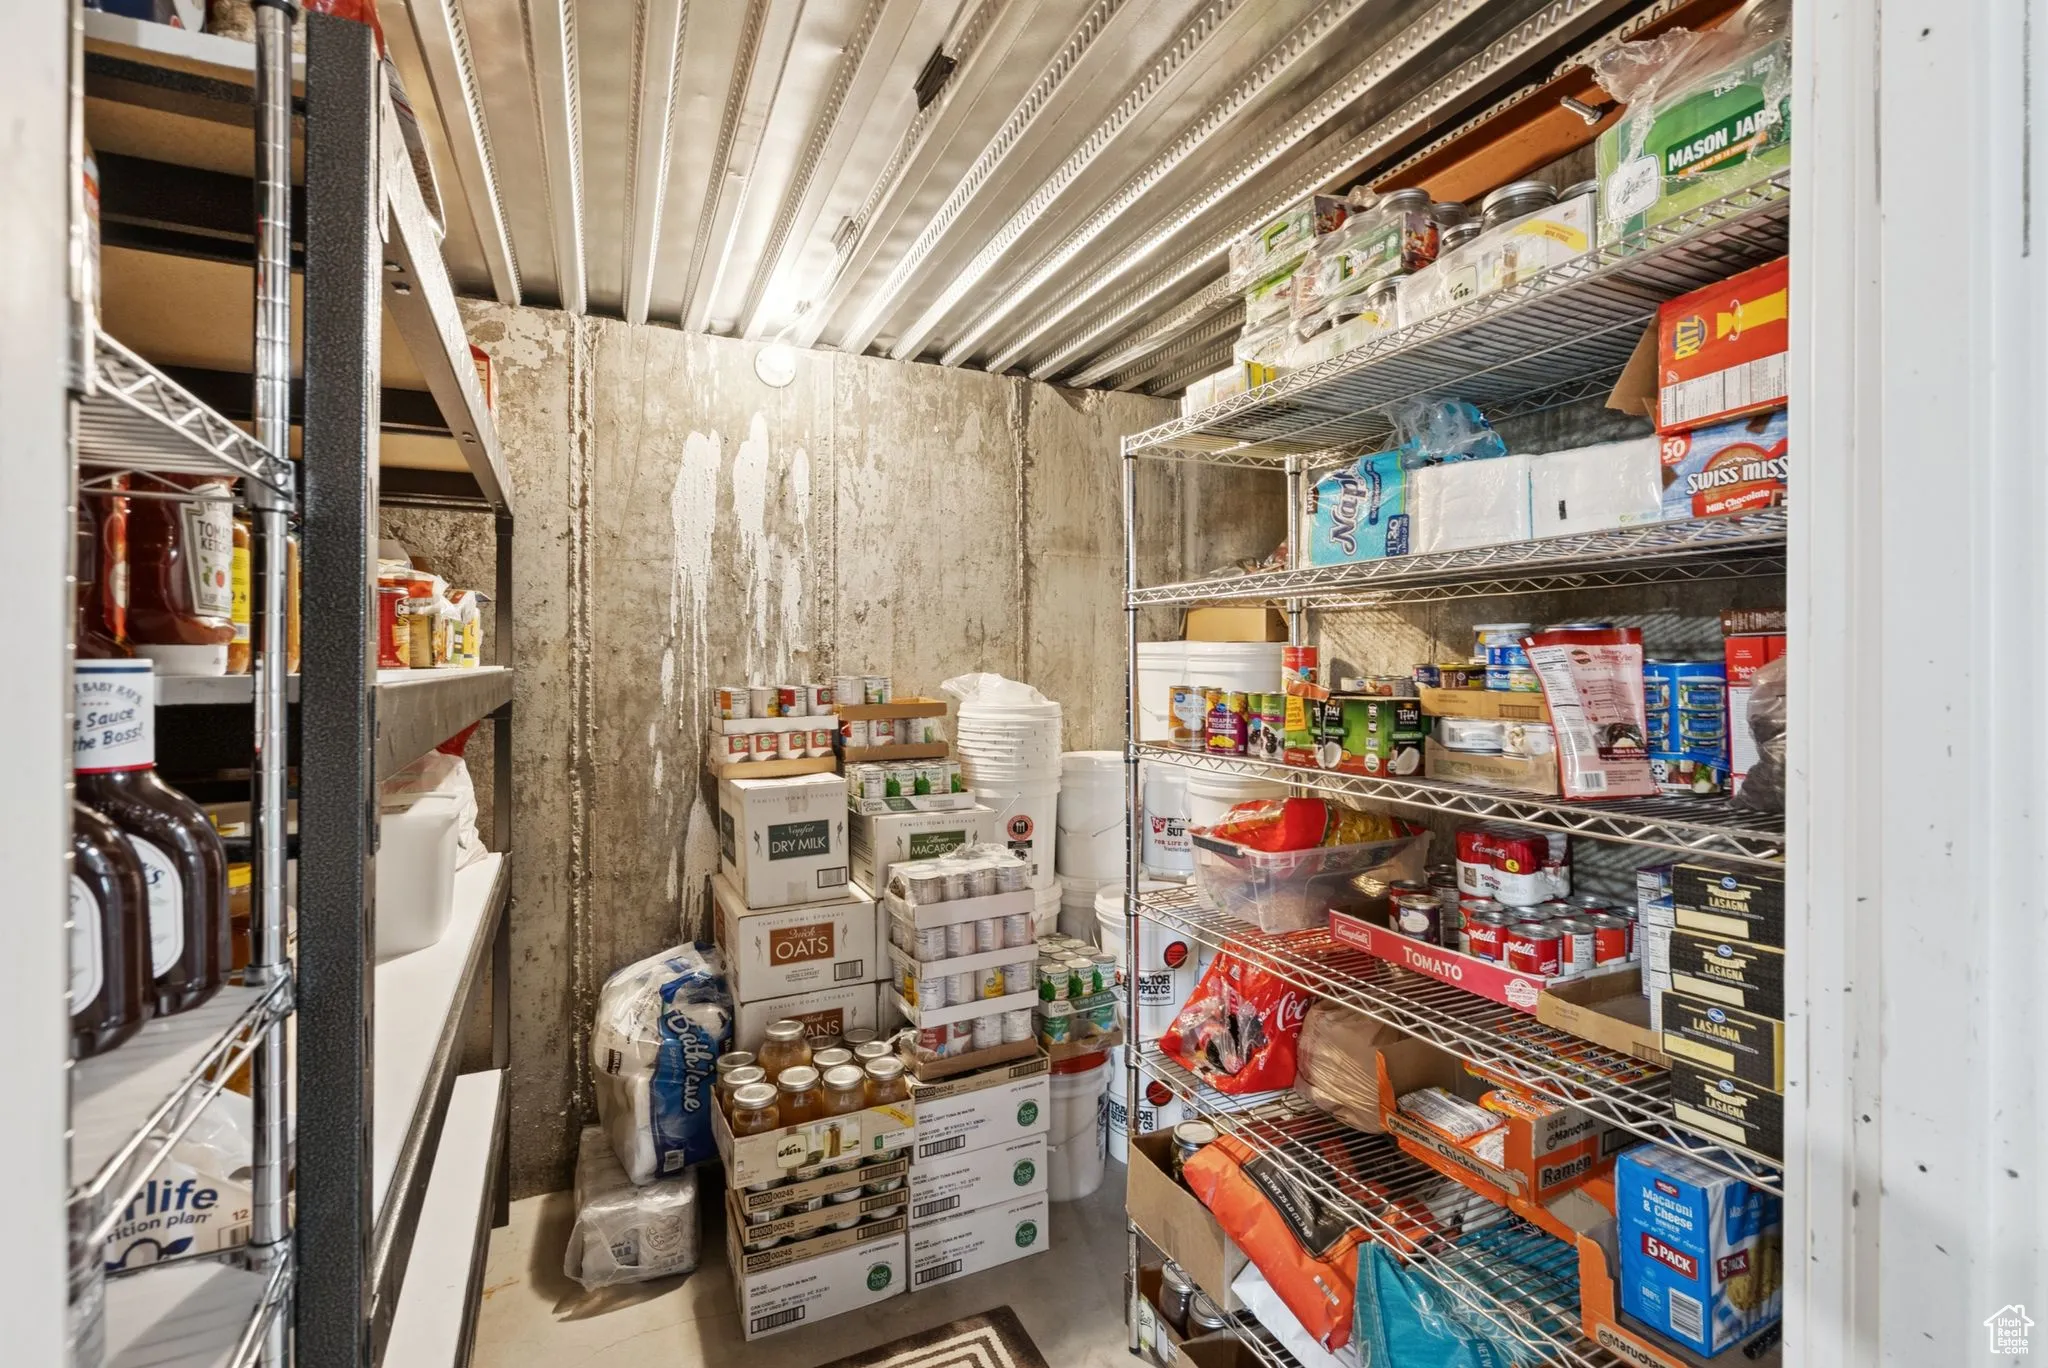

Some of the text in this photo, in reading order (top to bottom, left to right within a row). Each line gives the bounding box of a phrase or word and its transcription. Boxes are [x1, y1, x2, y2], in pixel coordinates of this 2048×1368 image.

[1668, 127, 1728, 172] MASON
[1675, 314, 1698, 360] RITZ
[1662, 439, 1686, 460] 50
[1686, 466, 1740, 495] SWISS
[1706, 489, 1770, 513] Milk Chocolate
[86, 708, 135, 728] Sauce
[1397, 709, 1418, 721] THAI
[102, 721, 145, 746] Boss!
[772, 835, 826, 854] DRY MILK
[1708, 896, 1750, 913] LASAGNA
[776, 936, 829, 960] OATS
[1402, 945, 1463, 981] TOMATO
[1704, 963, 1745, 982] LASAGNA
[804, 1020, 840, 1038] ANS
[1692, 1017, 1741, 1043] LASAGNA
[1706, 1096, 1746, 1120] LASAGNA
[1437, 1143, 1487, 1178] Chicken
[1541, 1155, 1591, 1189] Ramen
[125, 1179, 218, 1221] rlife
[773, 1189, 794, 1200] 00245
[1260, 1172, 1272, 1185] NET
[1270, 1184, 1282, 1196] WT
[1279, 1194, 1288, 1204] 25
[1642, 1187, 1693, 1218] Macaroni
[232, 1209, 249, 1221] 12
[773, 1221, 795, 1232] 00245
[1643, 1199, 1693, 1231] & Cheese
[107, 1218, 160, 1243] rition
[771, 1250, 792, 1261] 00245
[1647, 1237, 1691, 1273] 5 PACK
[1721, 1260, 1728, 1278] 5
